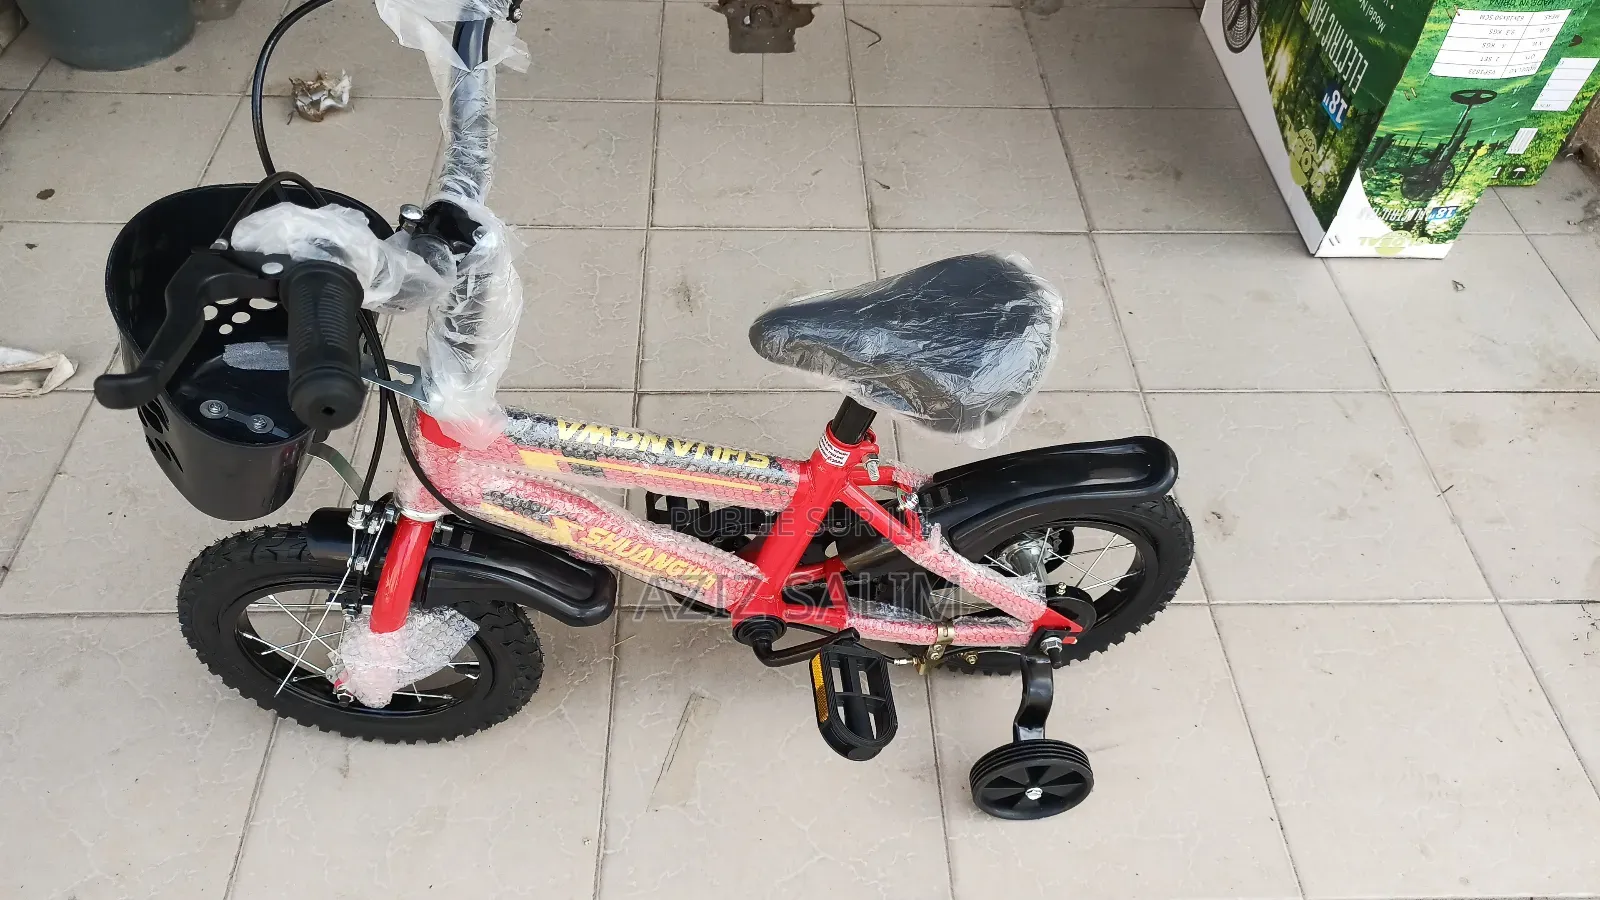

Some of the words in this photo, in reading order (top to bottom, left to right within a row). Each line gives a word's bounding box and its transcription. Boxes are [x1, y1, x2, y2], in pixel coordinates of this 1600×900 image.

[1306, 0, 1330, 38] FAN
[1364, 5, 1387, 35] Model
[1320, 13, 1368, 94] ELECTRIC
